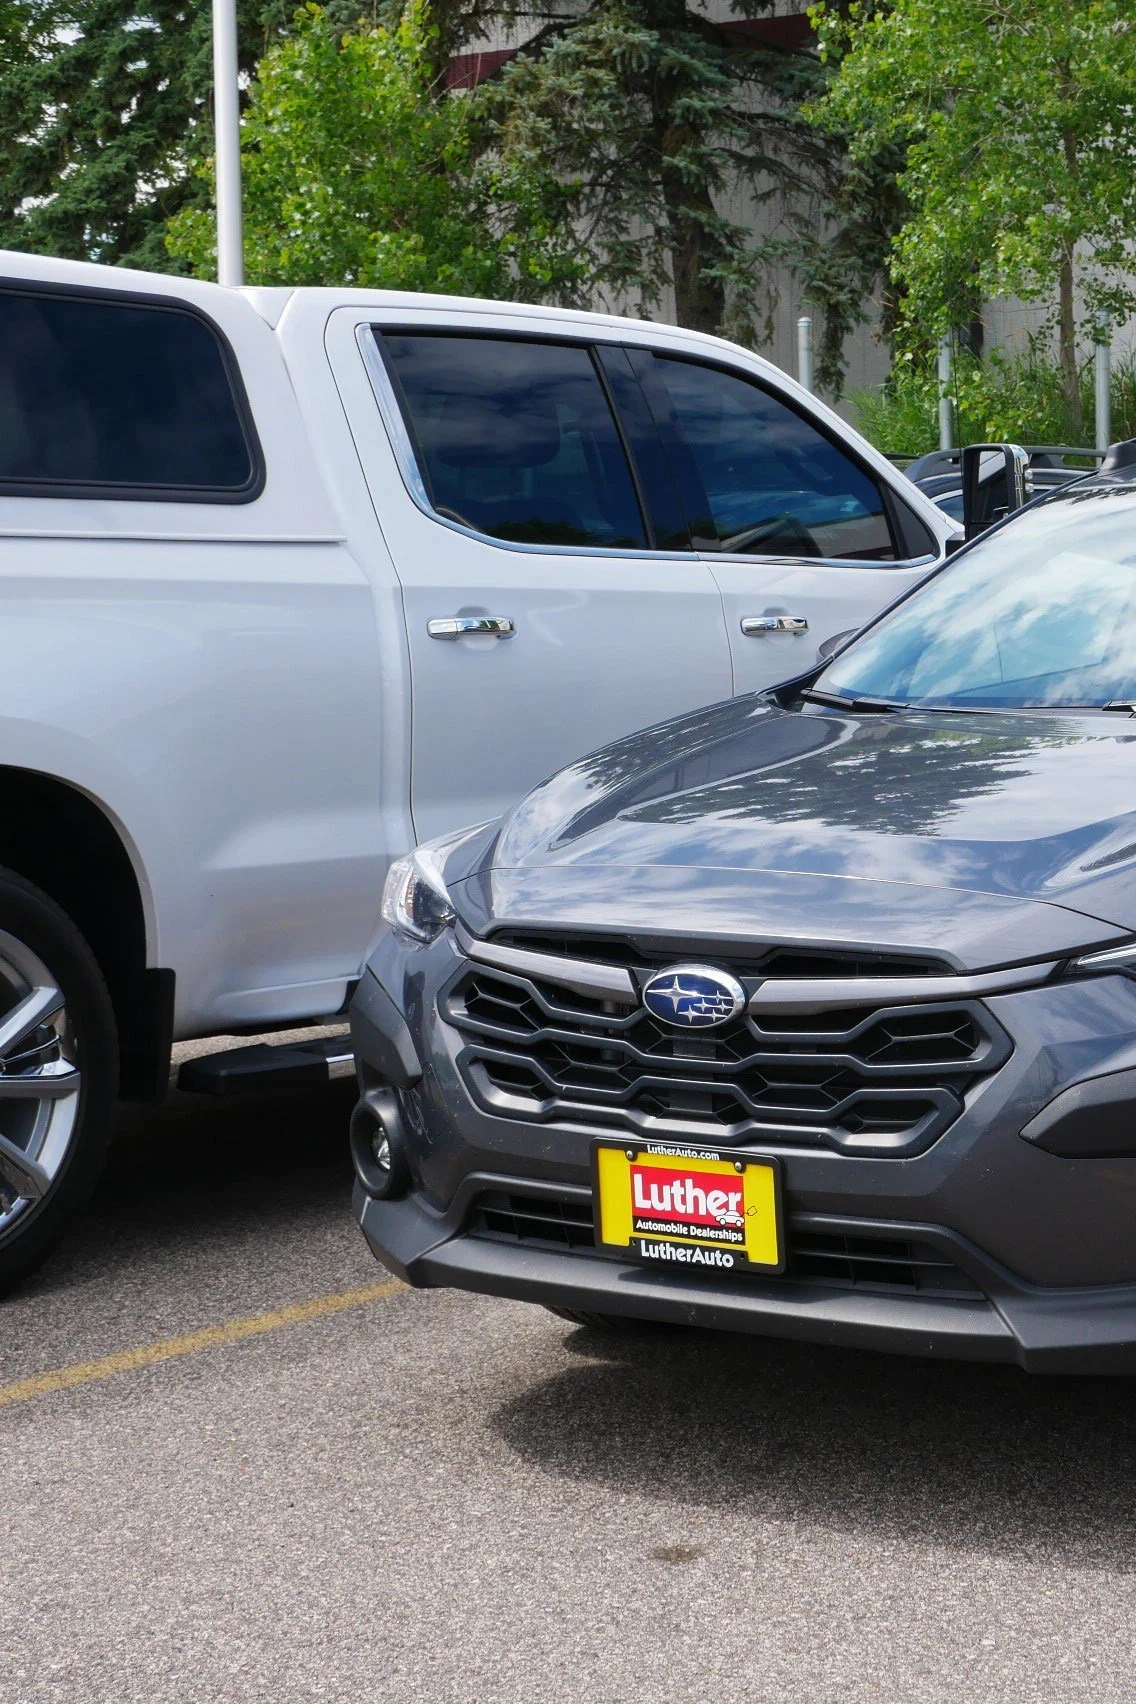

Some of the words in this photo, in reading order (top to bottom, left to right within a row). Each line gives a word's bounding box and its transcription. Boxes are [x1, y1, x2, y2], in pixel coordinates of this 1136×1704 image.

[647, 1145, 719, 1161] LutherAuto.com
[633, 1173, 742, 1216] Luther
[636, 1219, 688, 1235] Automobile
[689, 1226, 743, 1242] Dealerships
[640, 1240, 734, 1268] LutherAuto
